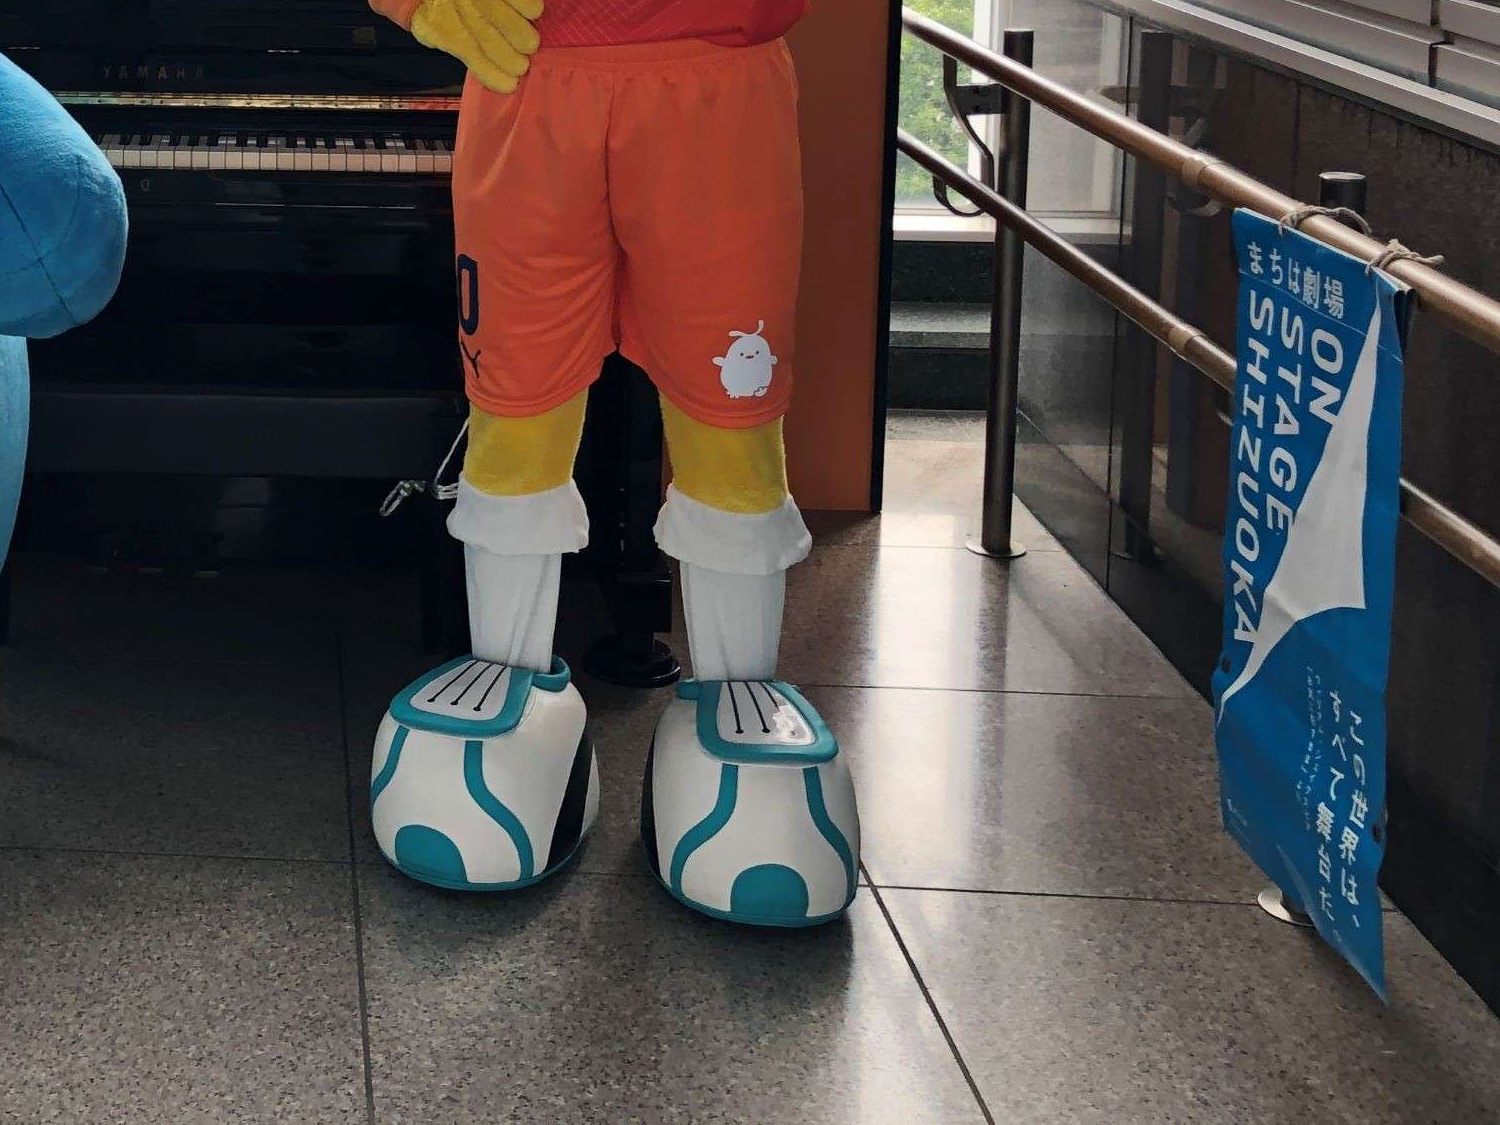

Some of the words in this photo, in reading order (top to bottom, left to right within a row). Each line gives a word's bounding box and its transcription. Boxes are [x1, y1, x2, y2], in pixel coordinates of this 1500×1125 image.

[1247, 241, 1345, 319] まちは劇場
[1266, 306, 1304, 530] STAGE
[1308, 328, 1344, 427] ON
[1230, 289, 1274, 642] SHIZUOKA
